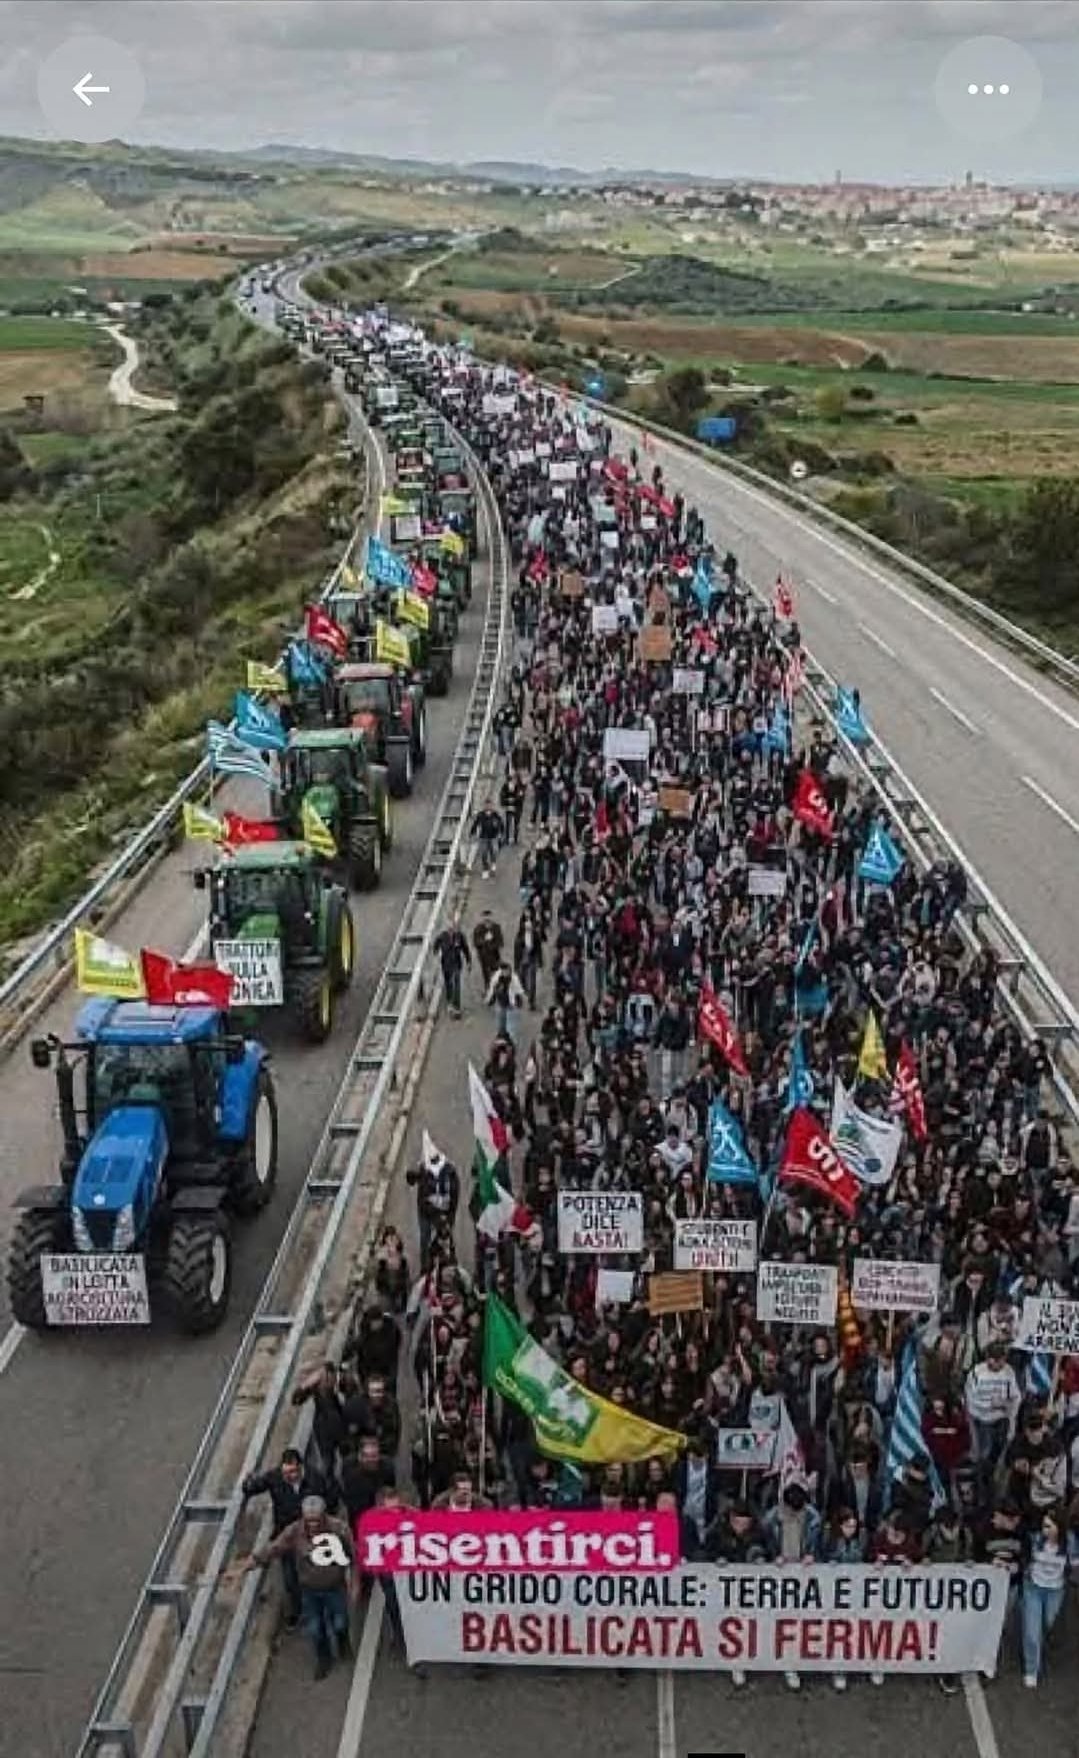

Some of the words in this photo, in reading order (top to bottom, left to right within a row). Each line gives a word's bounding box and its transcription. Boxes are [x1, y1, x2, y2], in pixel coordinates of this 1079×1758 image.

[562, 1195, 637, 1211] POTENZA
[407, 1571, 451, 1603] UN
[463, 1573, 562, 1605] GRIDO
[573, 1574, 707, 1608] CORALE:
[719, 1576, 823, 1610] TERRA
[834, 1578, 852, 1610] E
[862, 1576, 992, 1612] FUTURO
[461, 1611, 703, 1658] BASILICATA
[717, 1615, 757, 1660] SI
[774, 1618, 938, 1661] FERMA!
